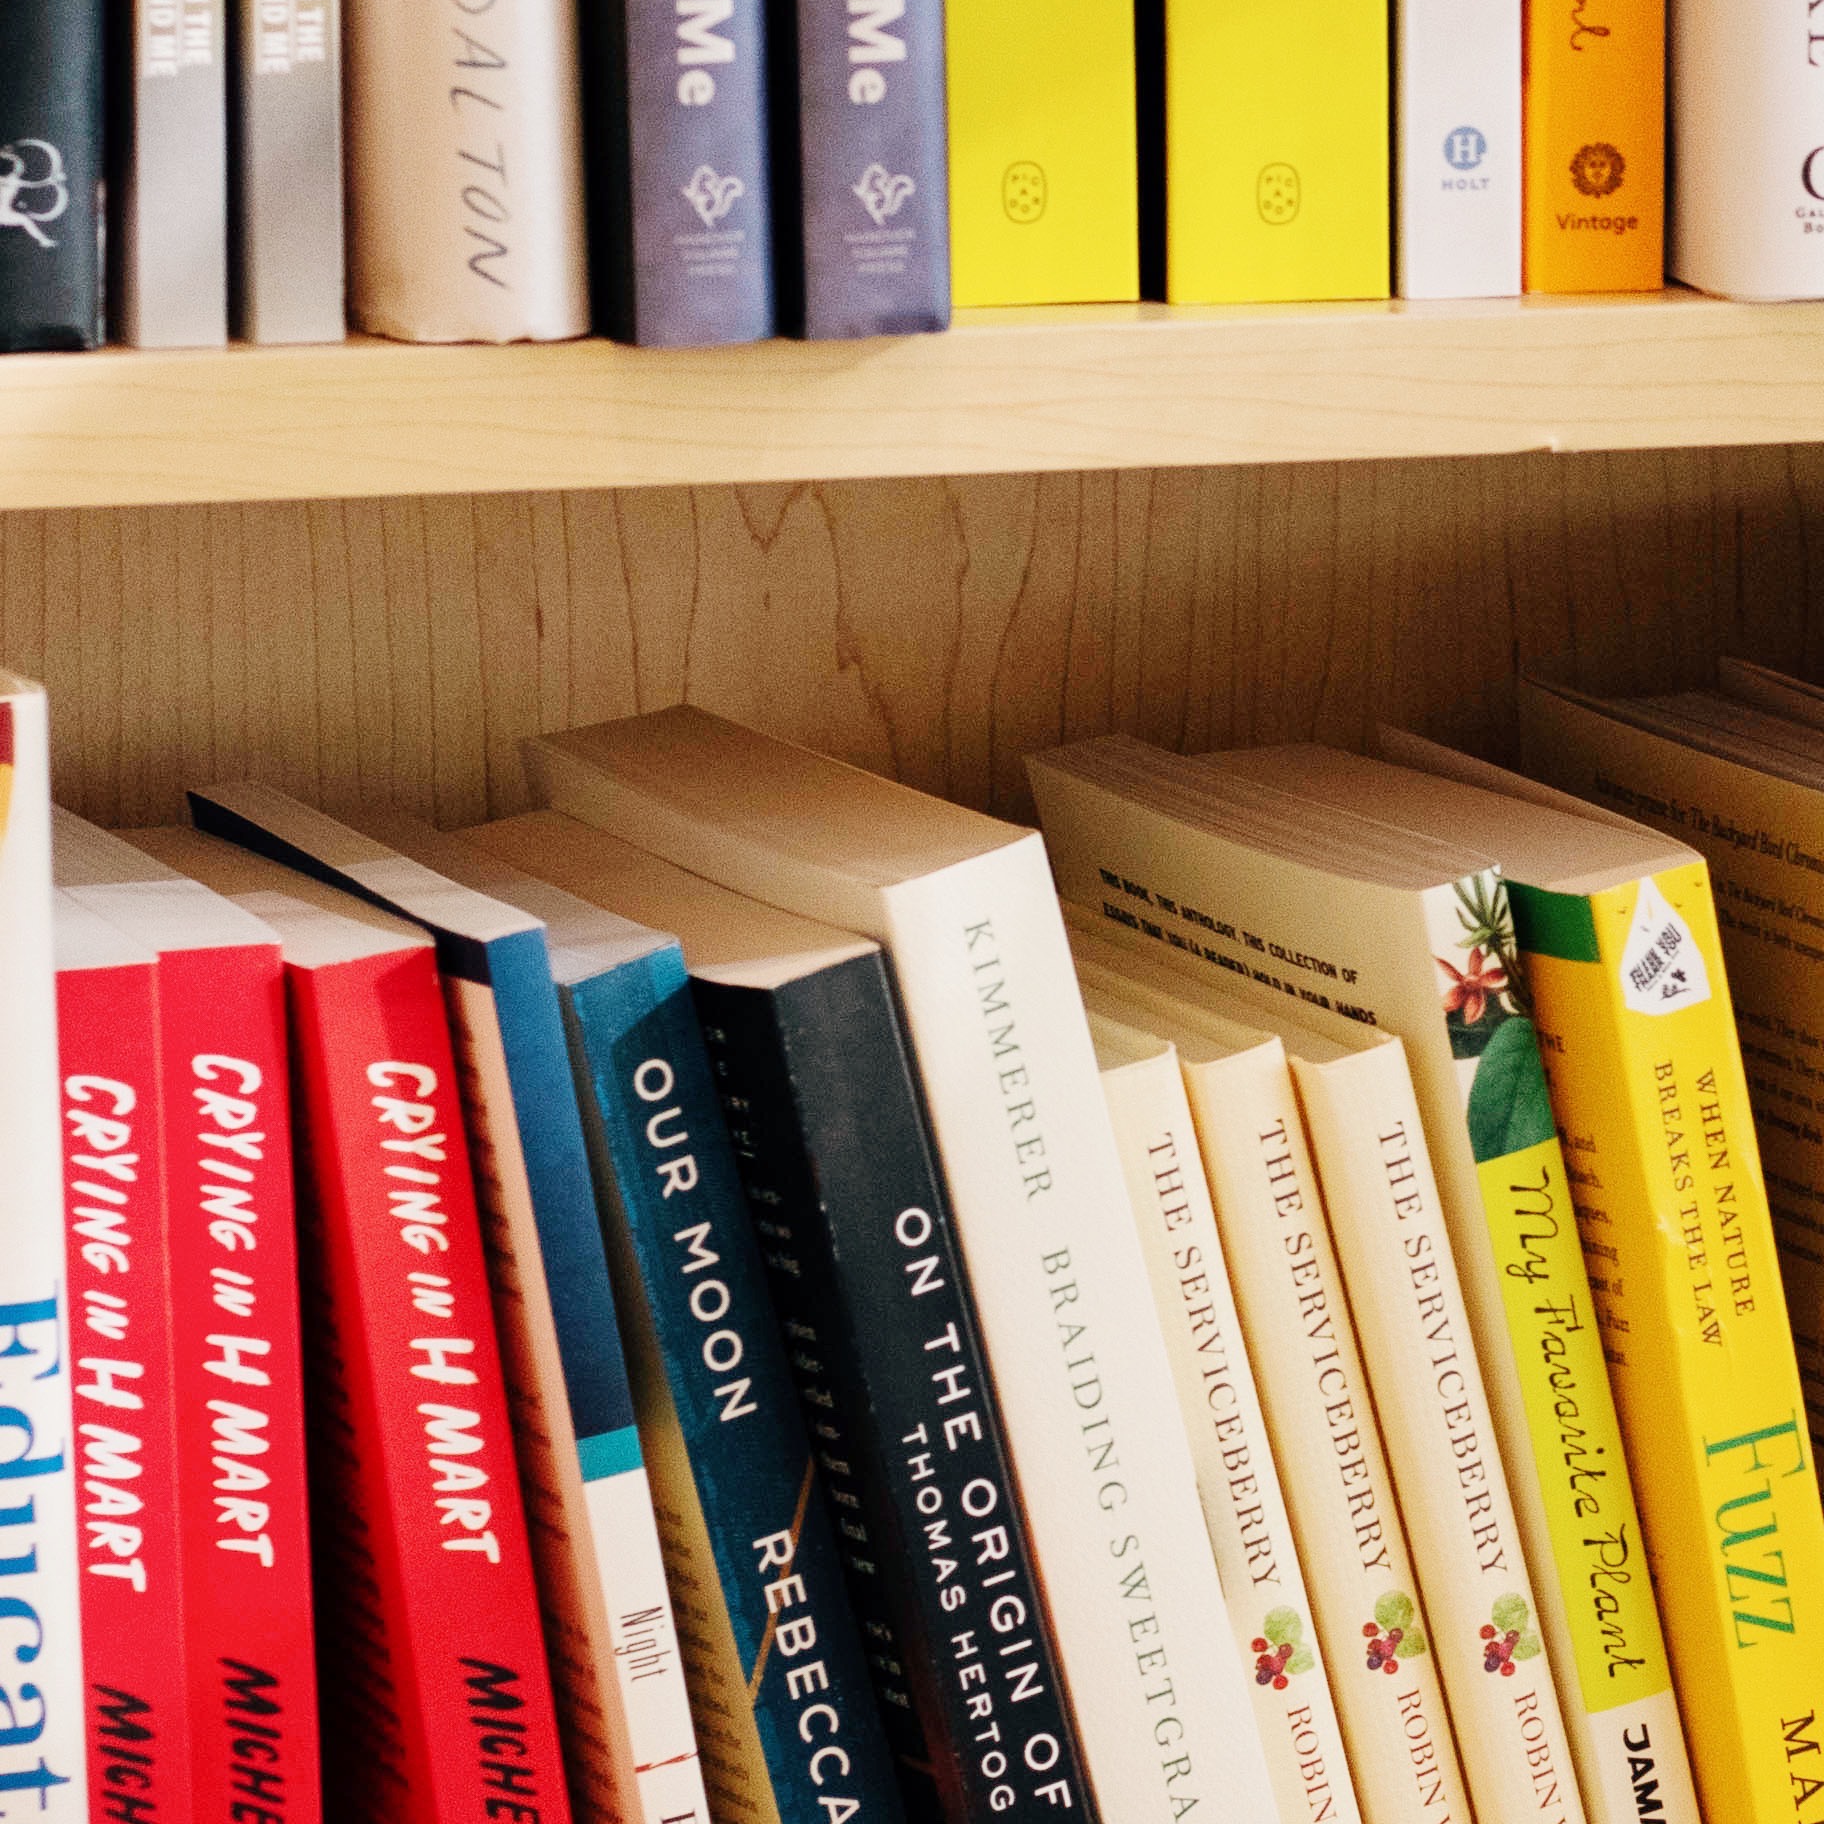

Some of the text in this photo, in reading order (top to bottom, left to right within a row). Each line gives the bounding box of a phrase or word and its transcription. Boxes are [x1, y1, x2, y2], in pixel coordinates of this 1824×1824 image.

[1555, 212, 1639, 235] Vintage
[964, 917, 1054, 1205] KIMMERER
[366, 1060, 499, 1564] CRYING IN H MART
[633, 1058, 701, 1201] OUR
[673, 1221, 760, 1425] MOON
[1041, 1248, 1130, 1516] BRAIDING
[1258, 1118, 1395, 1576] THE SERVICEBERRY
[614, 1604, 674, 1686] Night
[896, 1207, 945, 1296] ON
[923, 1323, 982, 1453] THE
[960, 1479, 1047, 1704] ORIGIN
[1023, 1732, 1073, 1810] OF
[900, 1424, 1015, 1814] THOMAS HERTOG
[1703, 1412, 1806, 1649] Fuzz
[1395, 1689, 1449, 1808] ROBIN
